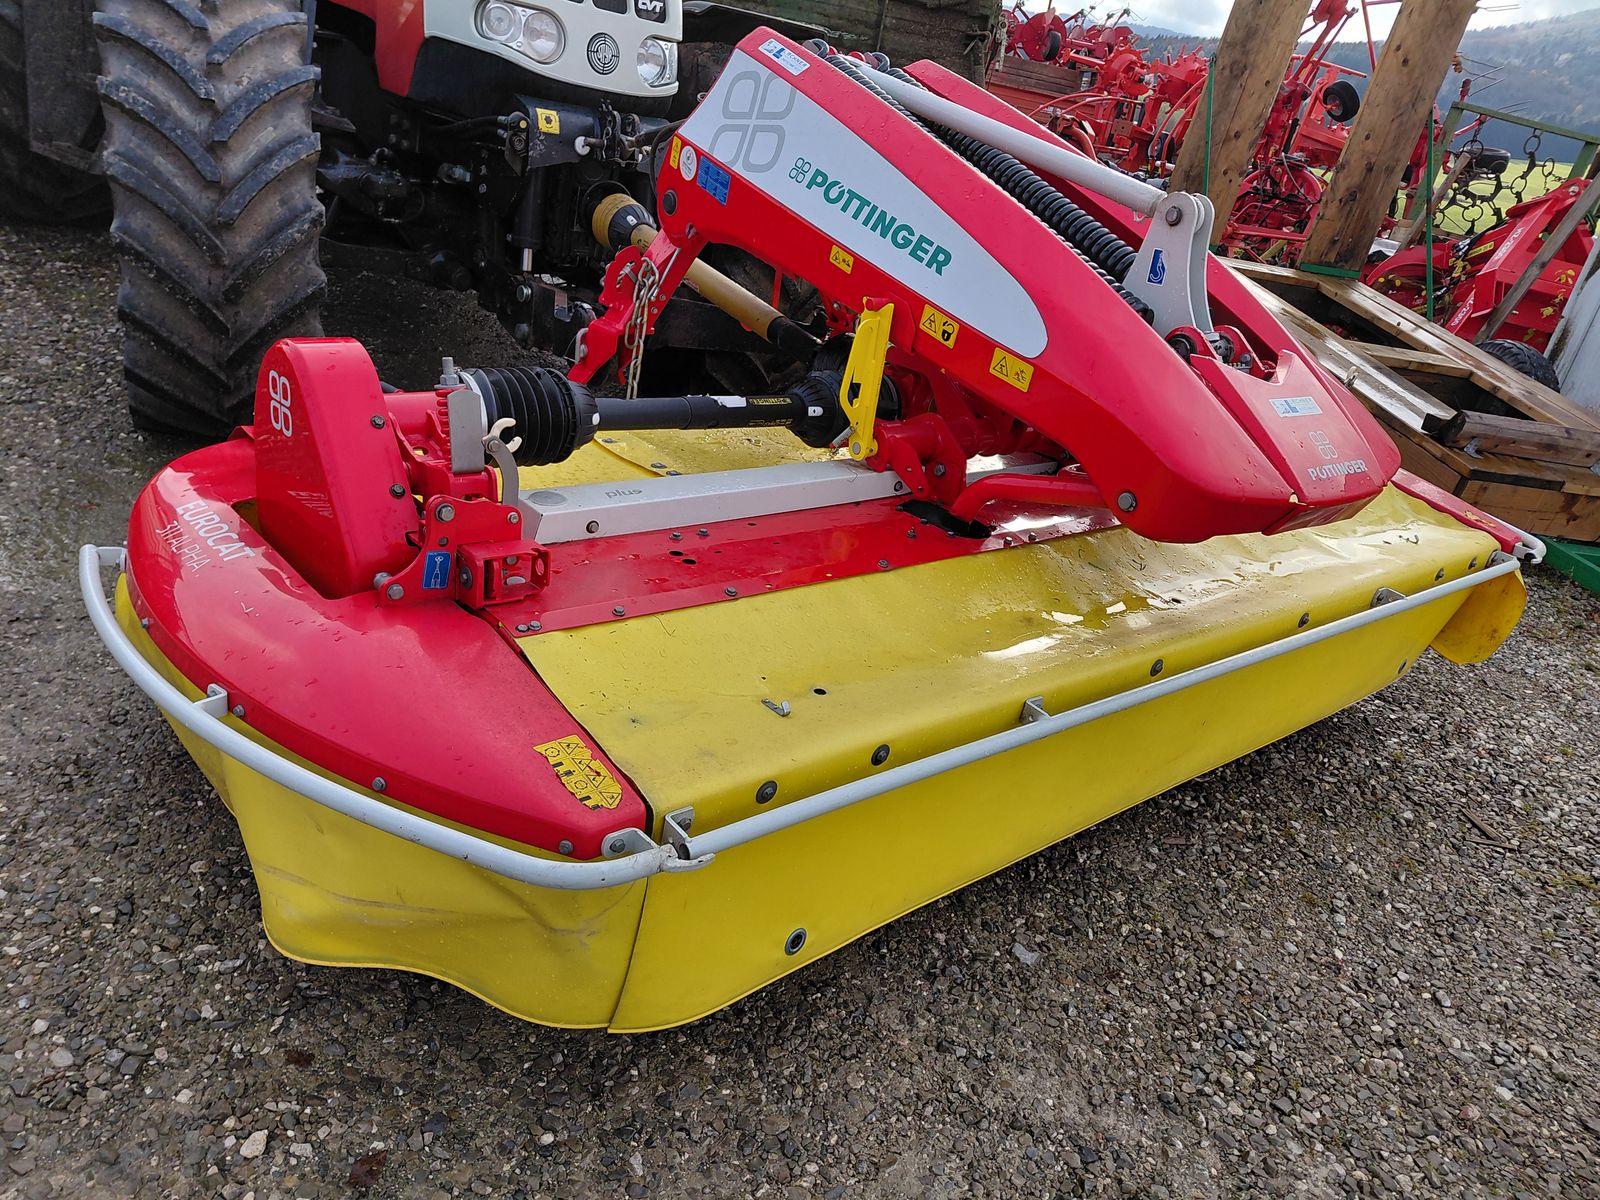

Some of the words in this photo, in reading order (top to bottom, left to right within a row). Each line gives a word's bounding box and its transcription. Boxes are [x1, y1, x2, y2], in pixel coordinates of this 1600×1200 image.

[638, 0, 663, 12] CVT
[605, 489, 642, 499] plus
[176, 499, 256, 561] EUROCAT
[167, 535, 212, 573] ALPHA
